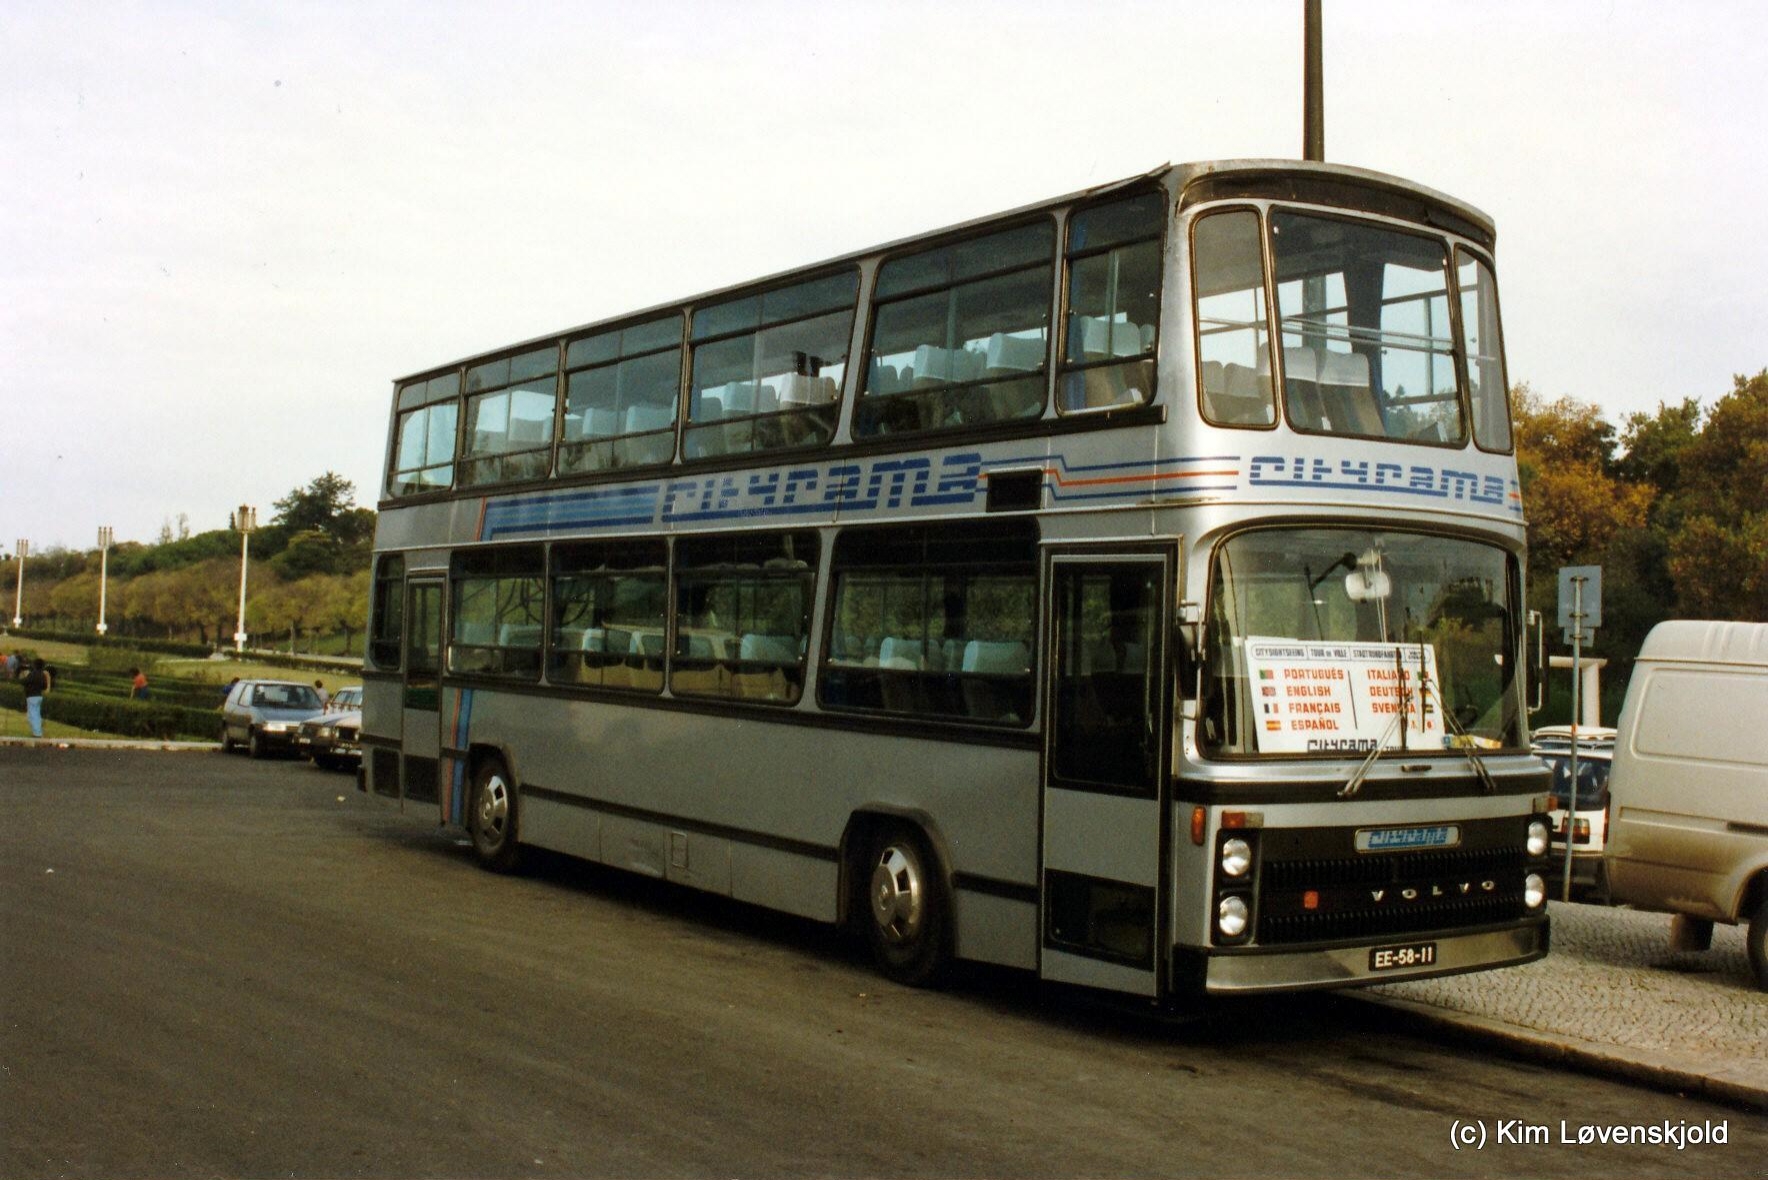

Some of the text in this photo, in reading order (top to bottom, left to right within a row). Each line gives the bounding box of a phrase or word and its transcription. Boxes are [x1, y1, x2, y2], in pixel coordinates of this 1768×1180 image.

[1367, 669, 1411, 680] ITALIAO
[1286, 686, 1331, 697] ENGLISH
[1288, 703, 1341, 715] FRANÇAIS
[1371, 702, 1416, 714] SVENA
[1291, 716, 1340, 730] ESPAÑOL
[1371, 880, 1495, 902] VOLVO
[1375, 946, 1433, 969] EE-58-11
